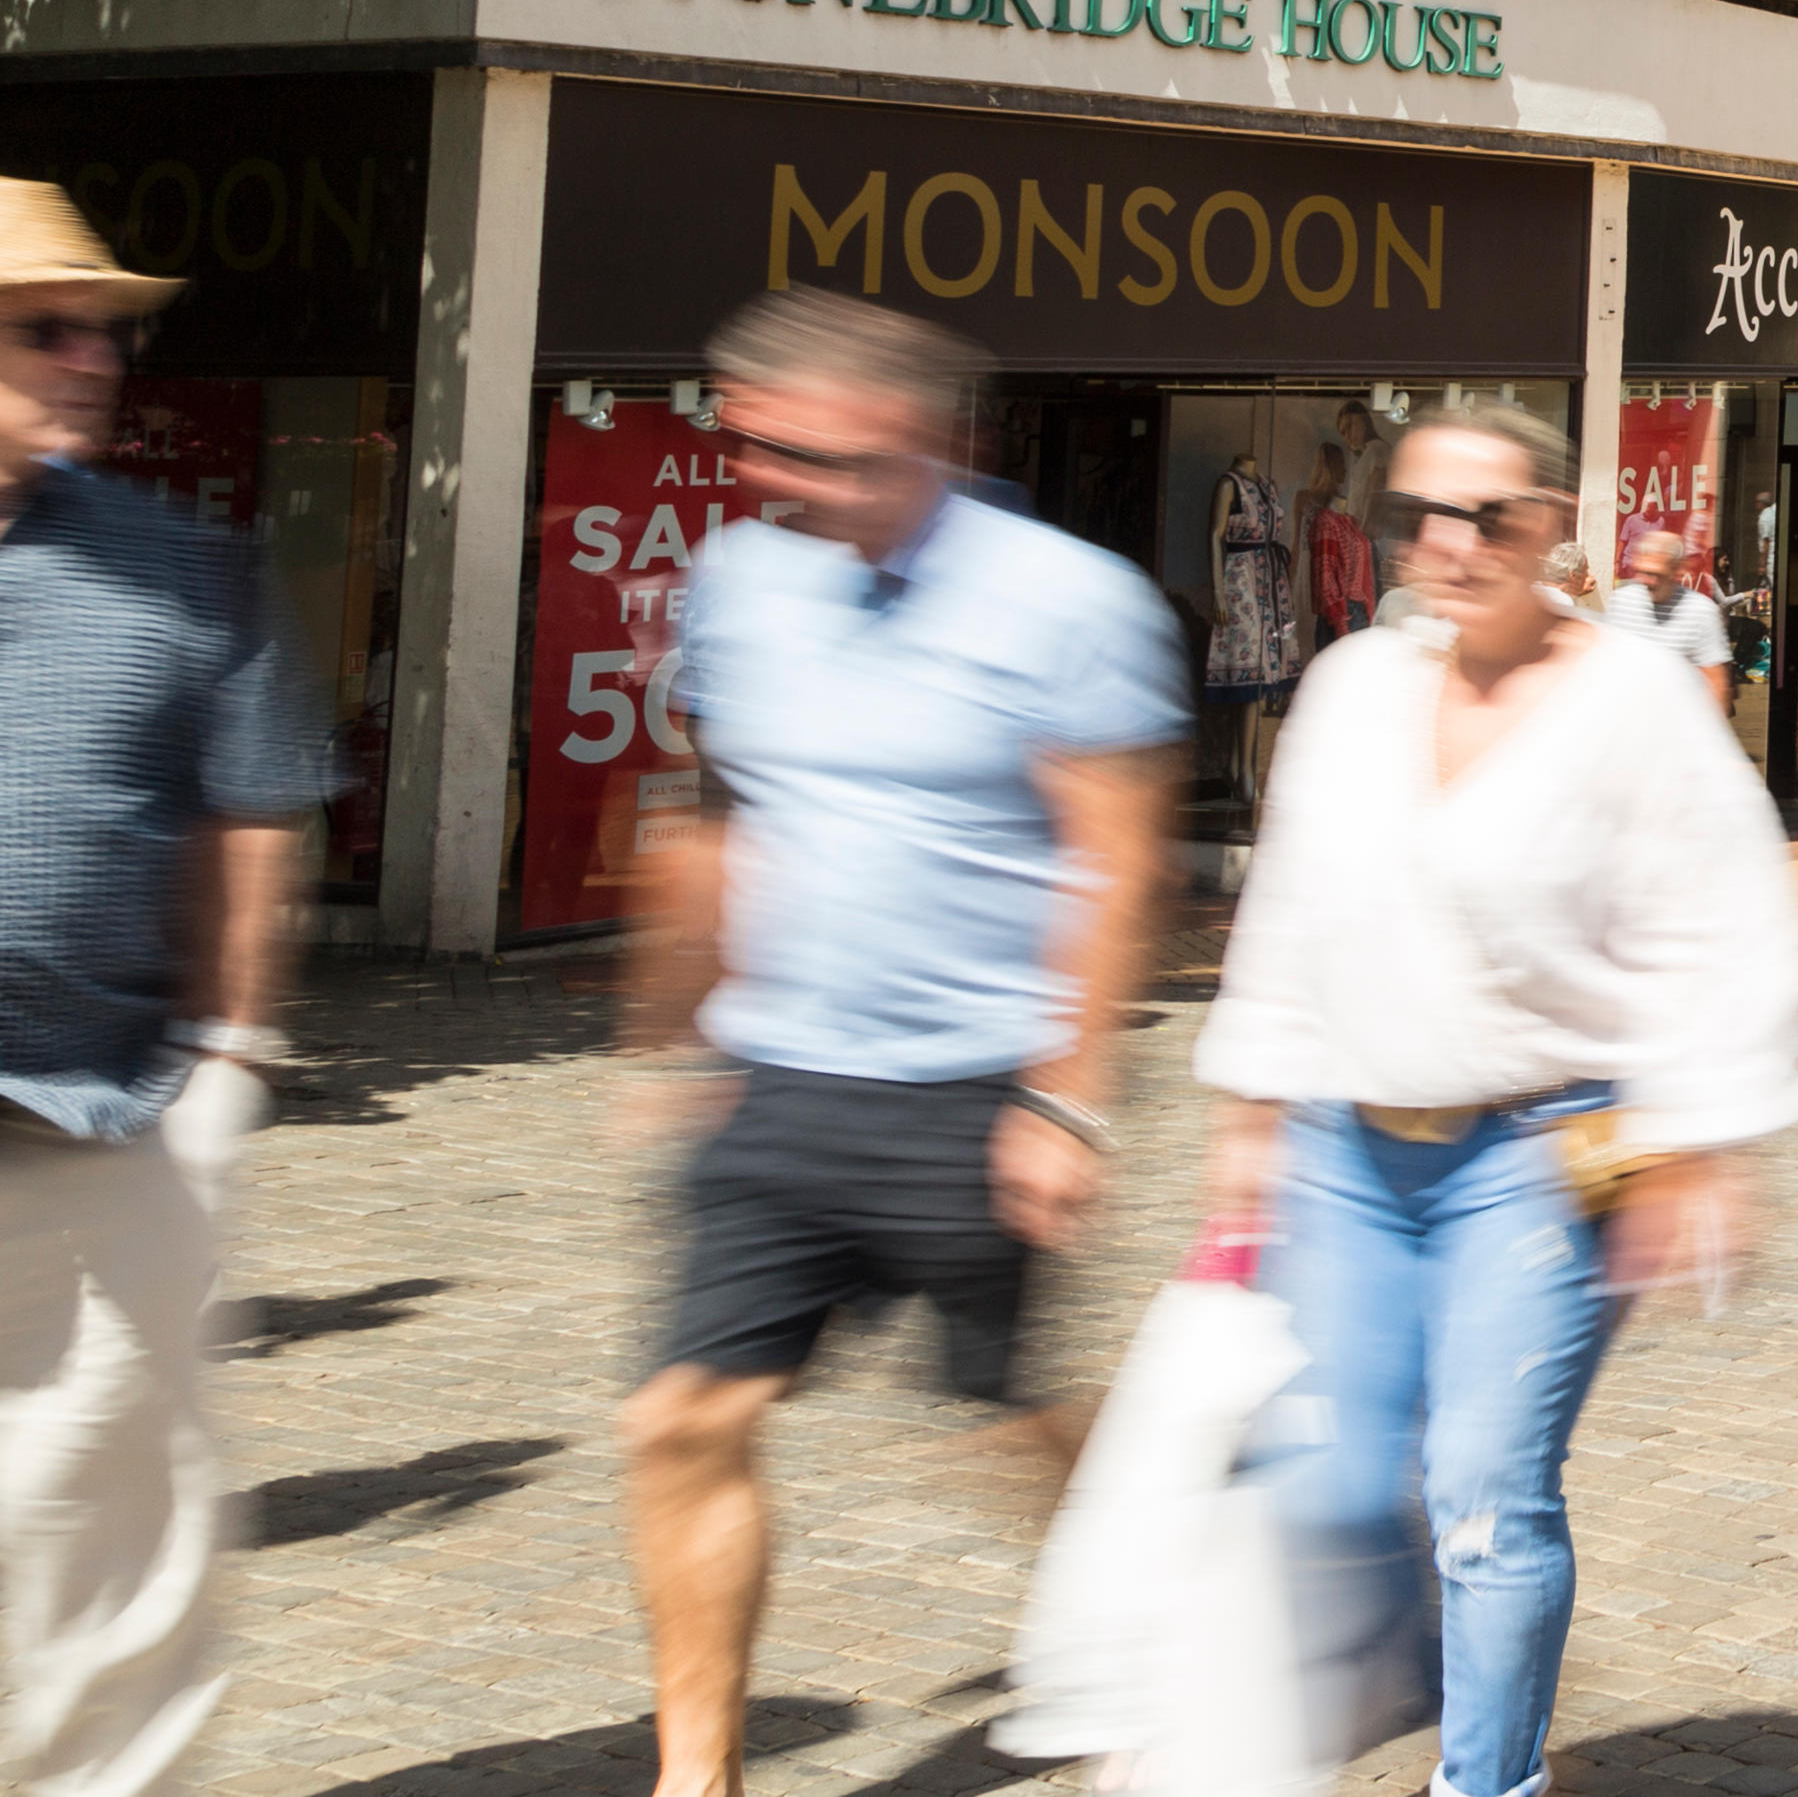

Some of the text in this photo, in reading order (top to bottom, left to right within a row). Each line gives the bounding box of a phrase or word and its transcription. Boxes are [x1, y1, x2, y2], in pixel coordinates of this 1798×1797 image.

[767, 163, 1445, 310] MONSOON
[653, 453, 738, 487] ALL
[1616, 464, 1708, 515] SALE
[619, 587, 695, 623] ITE
[647, 785, 666, 795] ALL
